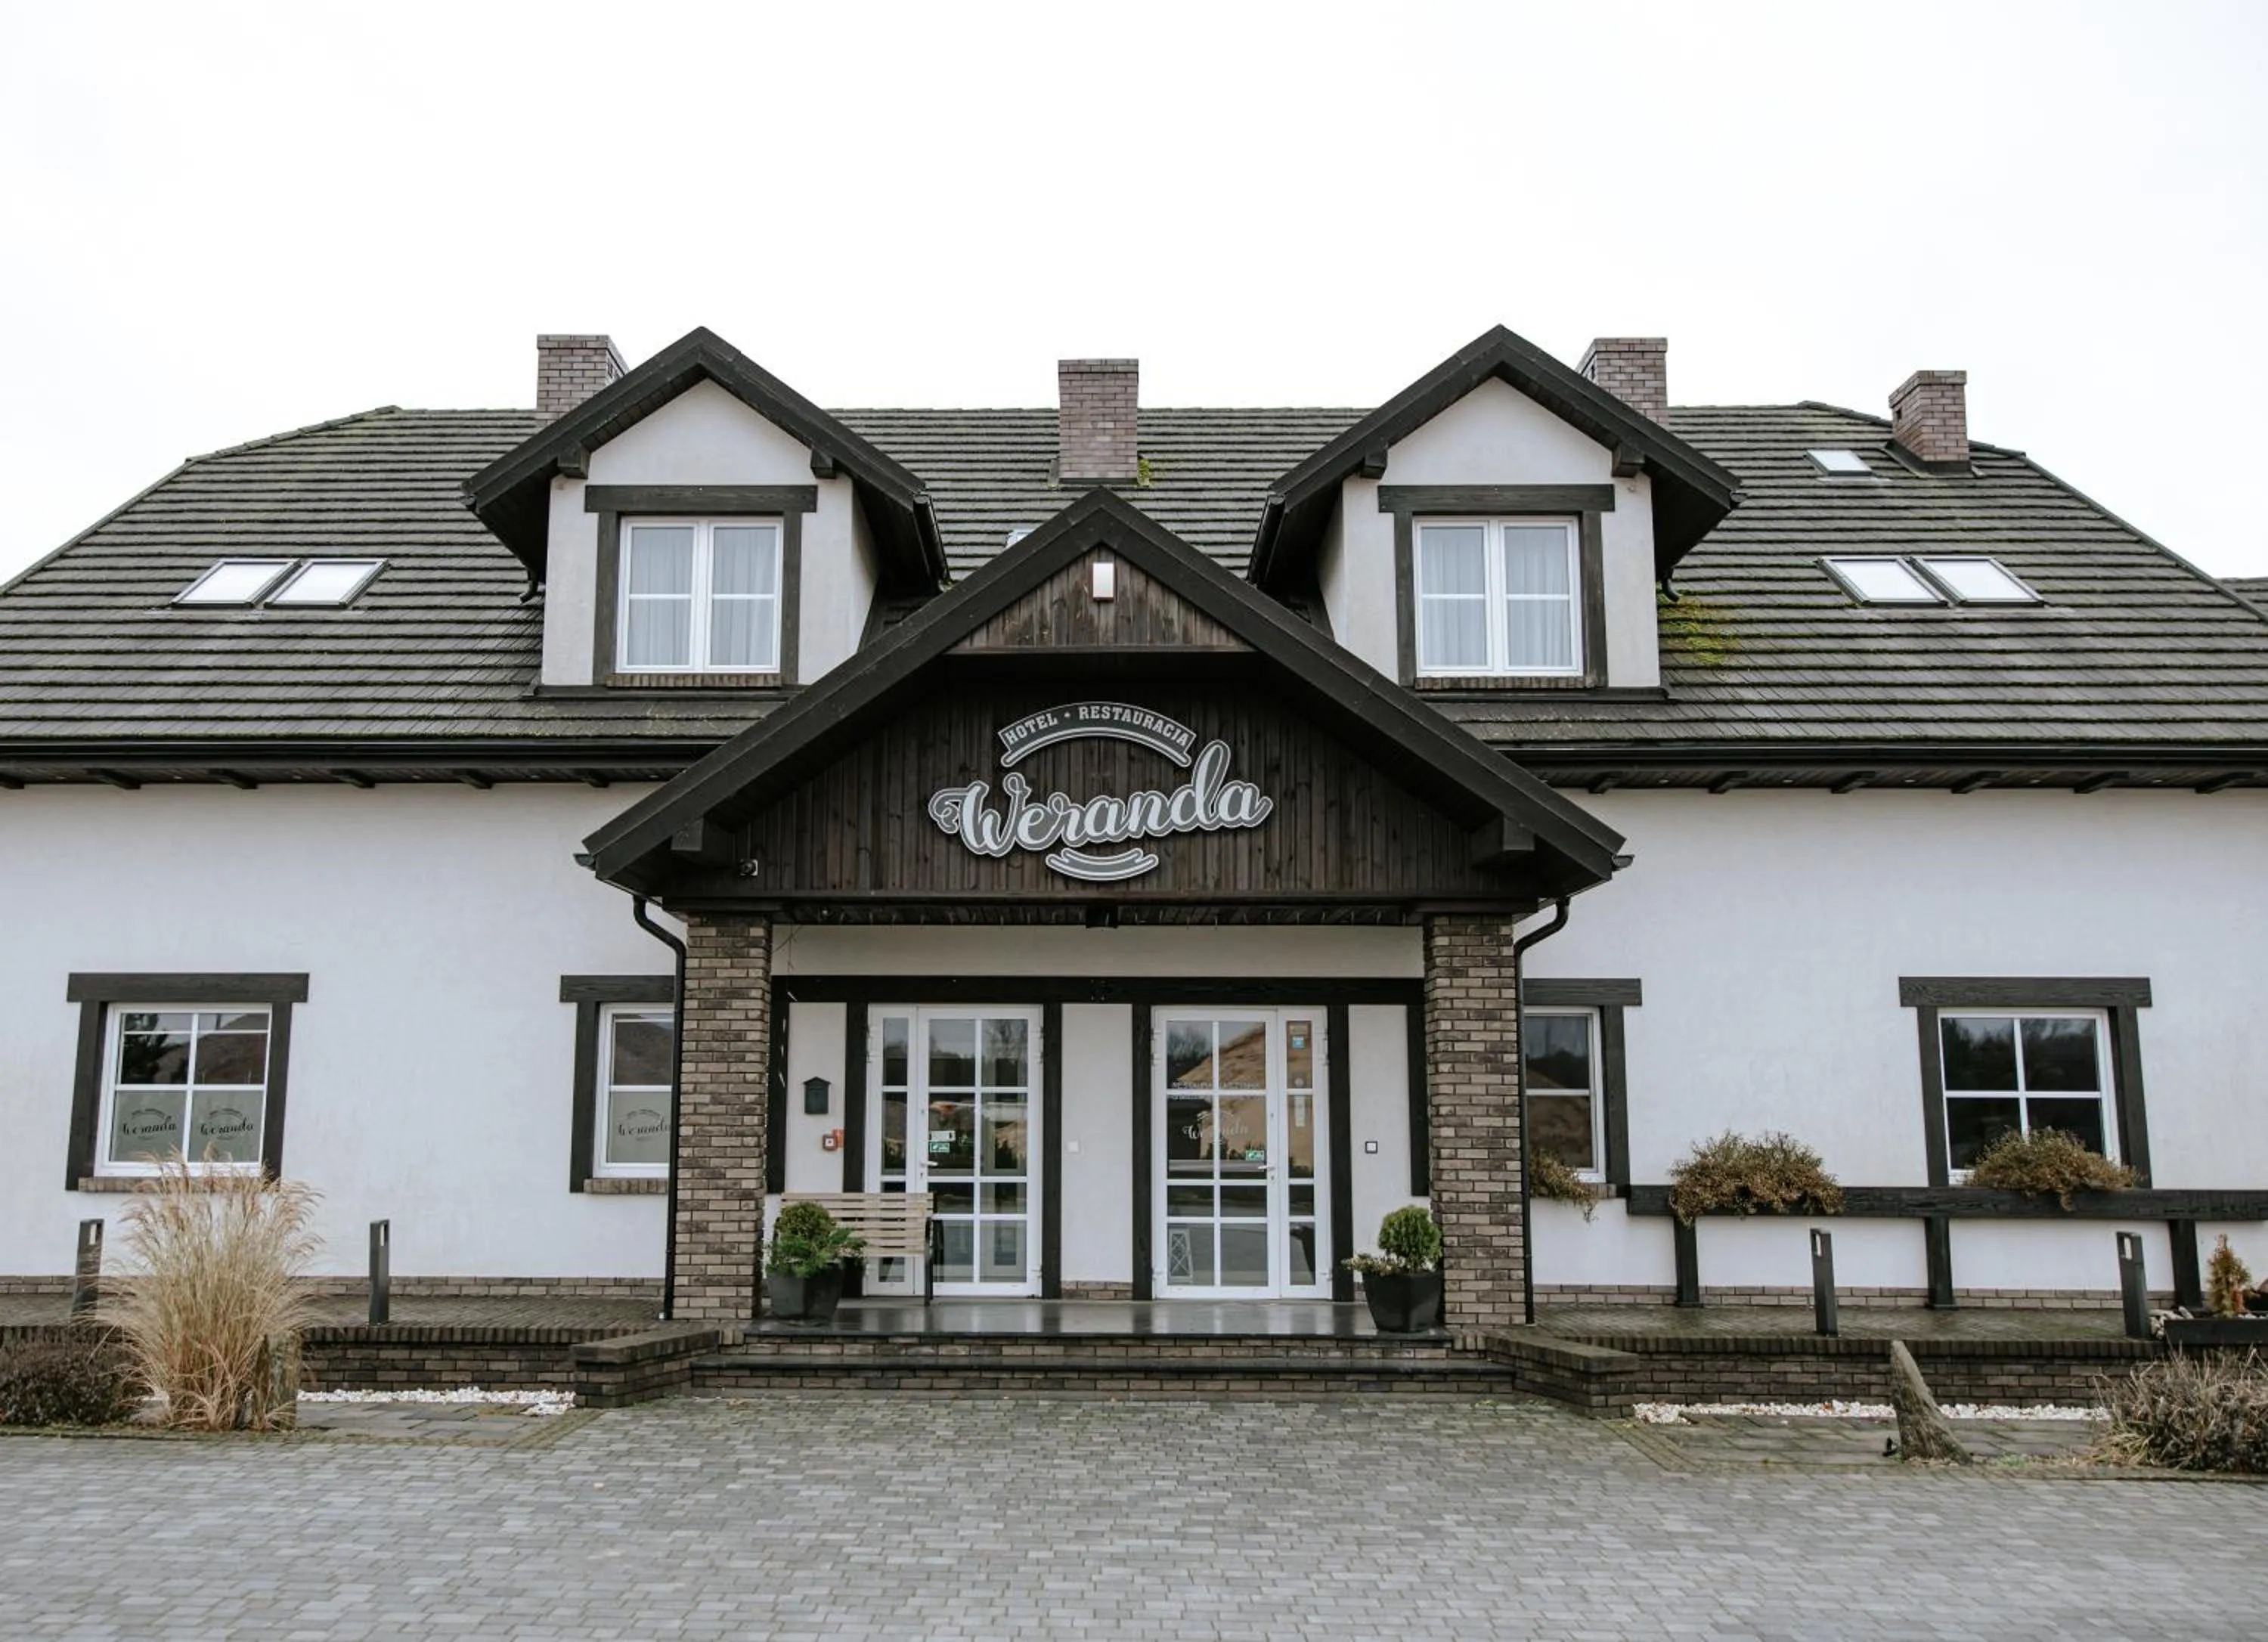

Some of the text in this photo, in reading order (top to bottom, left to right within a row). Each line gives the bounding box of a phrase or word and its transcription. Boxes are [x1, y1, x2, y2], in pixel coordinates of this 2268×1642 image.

[1004, 705, 1190, 747] HOTEL RESTAURACJA
[928, 739, 1273, 857] Weranda
